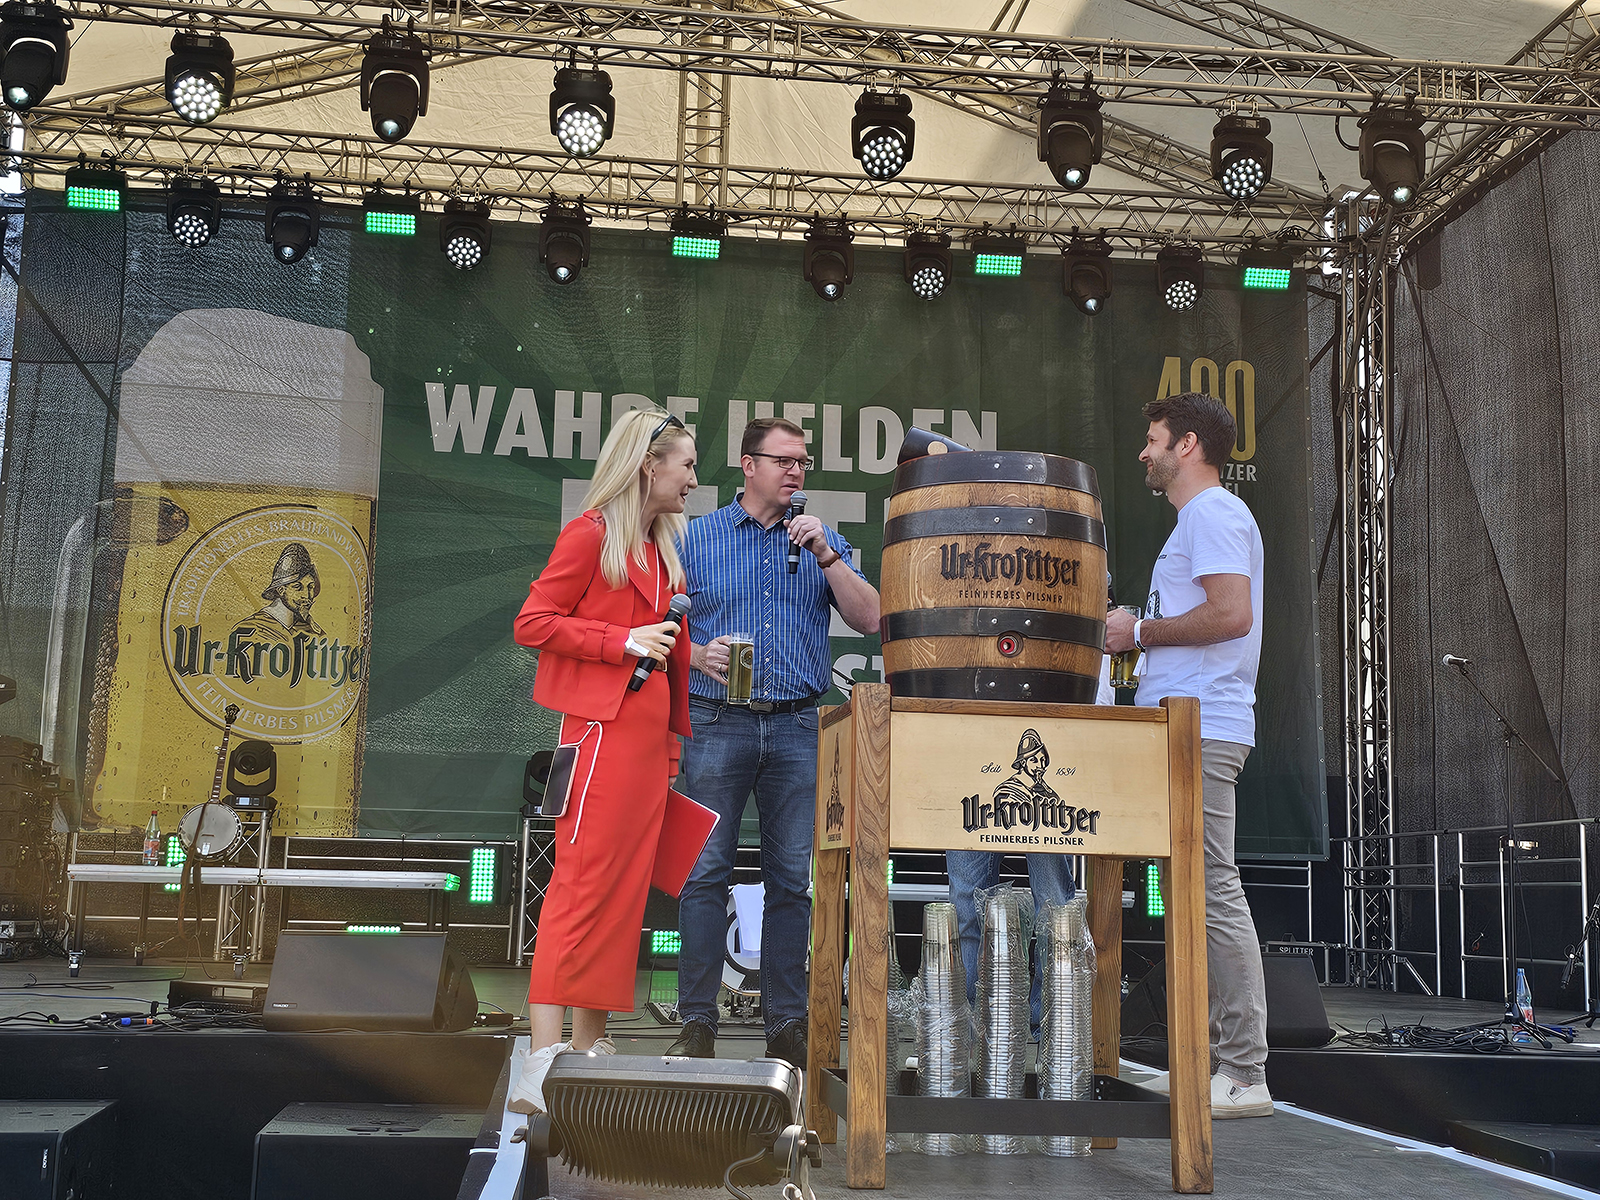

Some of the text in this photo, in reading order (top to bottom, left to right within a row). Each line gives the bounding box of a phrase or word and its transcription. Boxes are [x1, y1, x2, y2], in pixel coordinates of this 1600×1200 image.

[176, 523, 264, 618] TRADITIONELLES
[959, 589, 1063, 603] FEINHERBES PILSNER
[304, 686, 355, 728] PILSNER
[980, 762, 1002, 774] Seit
[980, 834, 1085, 846] FEINHERBES PILSNER
[1279, 946, 1314, 957] SPLITTER
